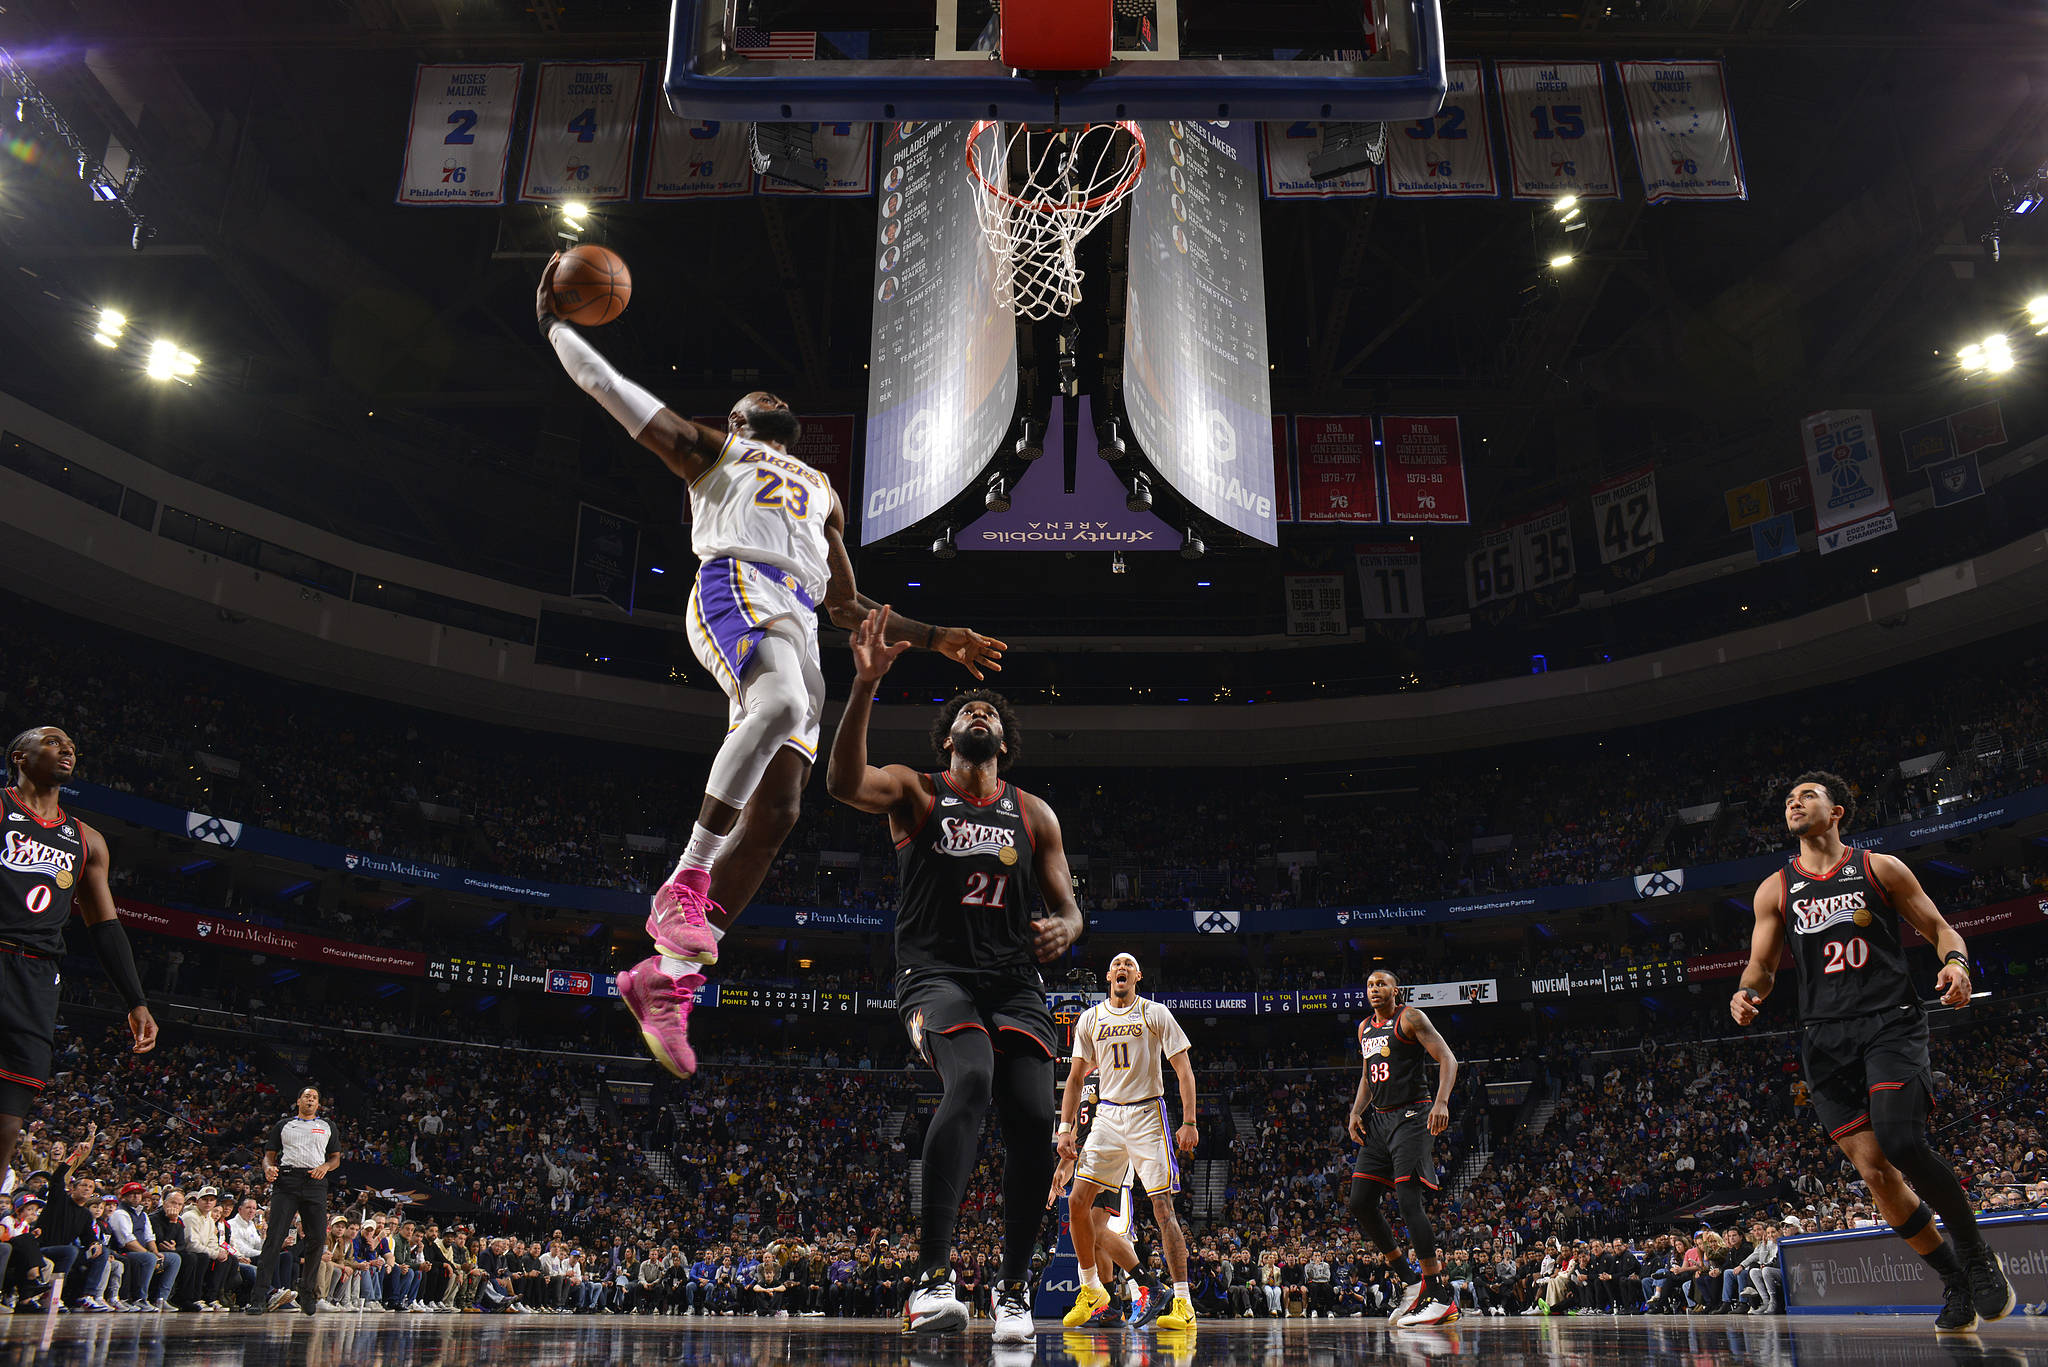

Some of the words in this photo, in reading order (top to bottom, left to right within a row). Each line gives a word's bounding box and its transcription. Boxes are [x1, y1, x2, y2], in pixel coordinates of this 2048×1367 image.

[451, 74, 486, 85] MOSES
[575, 72, 608, 83] DOLPH
[1540, 71, 1560, 80] HAL
[1655, 70, 1685, 80] DAVID
[447, 86, 487, 97] MALONE
[568, 84, 612, 95] SCHAYES
[1536, 82, 1568, 92] GREER
[444, 109, 478, 145] 2
[568, 108, 597, 143] 4
[1530, 105, 1585, 140] 15
[893, 126, 942, 165] PHILADELPHIA
[1207, 132, 1237, 161] LAKERS
[442, 167, 466, 183] 76
[566, 165, 589, 181] 76
[689, 161, 713, 177] 76
[1426, 161, 1452, 177] 76
[1552, 161, 1576, 177] 76
[1671, 159, 1698, 175] 76
[410, 189, 466, 197] Philadelphia
[657, 183, 714, 191] Philadelphia
[1279, 181, 1337, 190] Philadelphia
[1398, 182, 1458, 191] Philadelphia
[903, 206, 927, 225] MCCAIN
[901, 263, 927, 283] WALKER
[906, 293, 925, 307] TEAM
[924, 276, 944, 295] STATS
[1195, 277, 1213, 295] TEAM
[1212, 290, 1233, 308] STATS
[900, 348, 919, 365] TEAM
[918, 329, 945, 354] LEADERS
[1194, 329, 1211, 349] TEAM
[1211, 342, 1239, 365] LEADERS
[880, 378, 893, 389] STL
[879, 391, 893, 403] BLK
[1326, 424, 1343, 433] NBA
[1411, 424, 1429, 433] NBA
[1828, 414, 1860, 431] TOYOTA
[1317, 434, 1355, 443] EASTERN
[1402, 434, 1440, 444] EASTERN
[1816, 424, 1864, 453] BIG
[1310, 444, 1363, 454] CONFERENCE
[1396, 445, 1448, 455] CONFERENCE
[1313, 454, 1361, 464] CHAMPIONS
[1399, 455, 1447, 465] CHAMPIONS
[735, 447, 821, 489] LAKERS
[1406, 474, 1443, 484] 1979-80
[754, 467, 809, 520] 23
[1779, 476, 1802, 504] T
[1330, 495, 1349, 509] 76
[1417, 496, 1436, 510] 76
[1604, 494, 1653, 554] 42
[1846, 524, 1866, 536] 2025
[1867, 516, 1893, 530] MEN'S
[983, 531, 1066, 543] mobile
[1073, 530, 1155, 543] xfinity
[1760, 525, 1785, 552] V
[1847, 523, 1893, 543] CHAMPIONS
[1825, 534, 1839, 549] V
[1531, 527, 1571, 584] 35
[1472, 546, 1515, 601] 66
[1375, 569, 1409, 614] 11
[1909, 826, 1938, 838] Official
[1938, 817, 1978, 831] Healthcare
[1978, 808, 2005, 821] Partner
[941, 817, 1015, 850] SIXERS
[5, 830, 76, 872] SIXERS
[1848, 836, 1884, 851] dicine
[362, 856, 388, 872] Penn
[389, 861, 441, 880] Medicine
[464, 877, 490, 889] Official
[489, 882, 526, 896] Healthcare
[526, 887, 551, 899] Partner
[960, 872, 1010, 909] 21
[26, 883, 52, 913] 0
[1449, 904, 1474, 914] Official
[1473, 901, 1510, 911] Healthcare
[1510, 897, 1536, 907] Partner
[1353, 909, 1378, 920] Penn
[1378, 906, 1427, 919] Medicine
[1792, 891, 1867, 929] SIXERS
[143, 912, 169, 926] Partner
[811, 912, 835, 922] Penn
[836, 913, 884, 925] Medicine
[1950, 917, 1985, 930] ealthcare
[1985, 911, 2013, 923] Partner
[215, 923, 245, 939] Penn
[245, 928, 299, 949] Medicine
[322, 946, 349, 958] Official
[348, 950, 388, 965] Healthcare
[388, 956, 415, 967] Partner
[1824, 937, 1870, 974] 20
[431, 962, 445, 971] PHI
[1700, 960, 1738, 971] Healthcare
[429, 970, 444, 979] LAL
[450, 973, 458, 981] 11
[513, 973, 531, 983] 8:04
[530, 976, 545, 984] PM
[553, 977, 565, 987] 50
[576, 978, 589, 989] 50
[1571, 980, 1588, 988] 8:04
[1611, 983, 1624, 991] LAL
[722, 989, 748, 997] PLAYER
[722, 998, 748, 1006] POINTS
[867, 998, 897, 1009] PHILADE
[1163, 999, 1177, 1009] LOS
[1179, 999, 1212, 1009] ANGELES
[1215, 999, 1247, 1009] LAKERS
[1096, 1024, 1143, 1041] LAKERS
[1111, 1042, 1130, 1070] 11
[1370, 1062, 1391, 1084] 33
[1828, 1259, 1860, 1285] Penn
[1859, 1253, 1924, 1283] Medicine
[2002, 1251, 2048, 1275] Health
